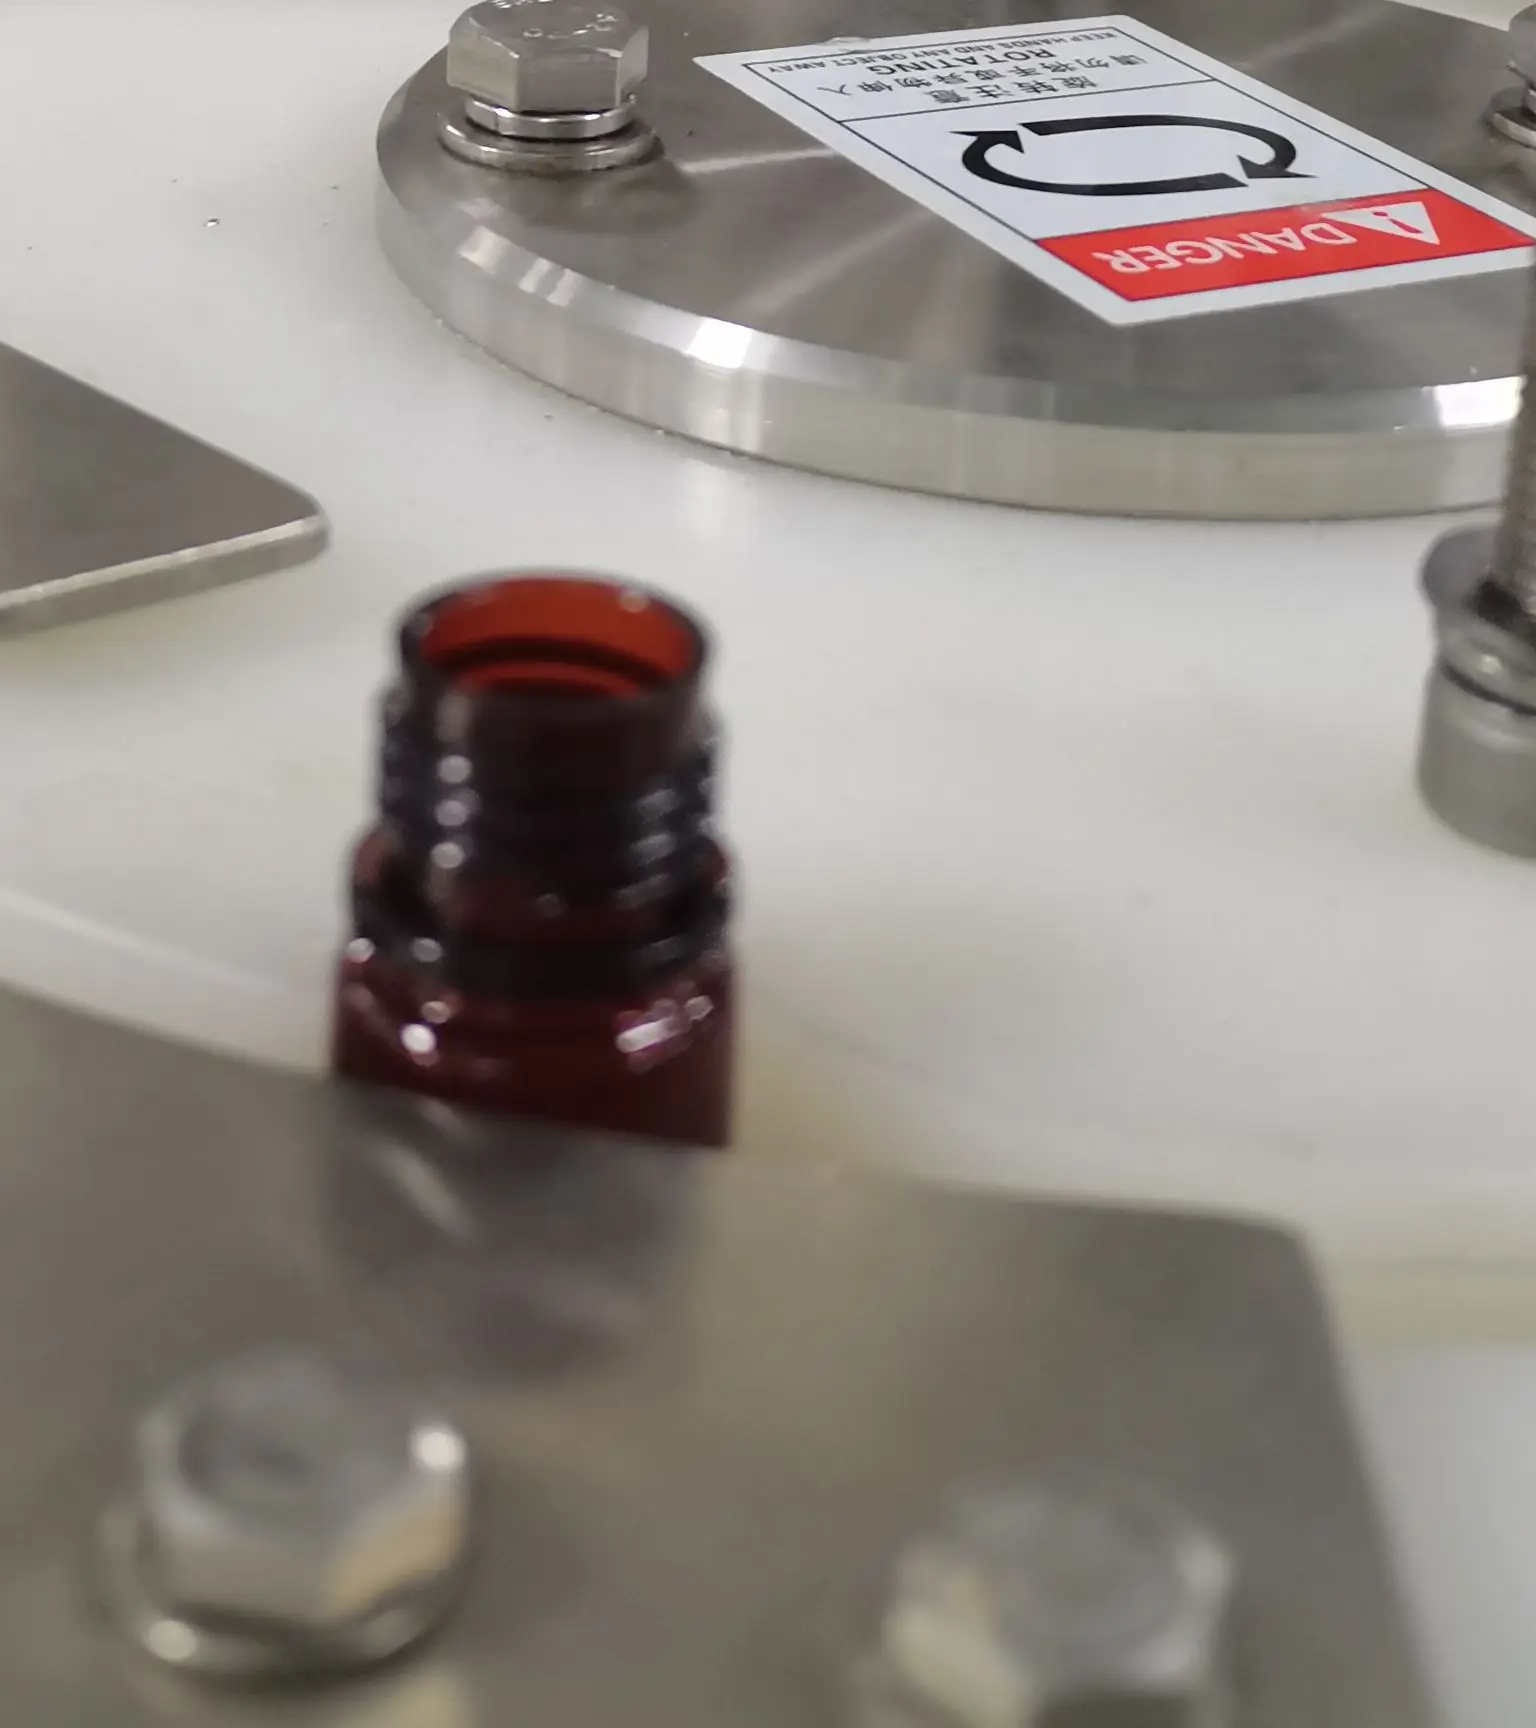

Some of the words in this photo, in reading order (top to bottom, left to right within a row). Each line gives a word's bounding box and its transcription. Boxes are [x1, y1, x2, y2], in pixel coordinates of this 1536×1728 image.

[998, 36, 1068, 49] HANDS
[1071, 31, 1117, 42] KEEP
[911, 48, 951, 58] ANY
[954, 44, 998, 54] AND
[831, 52, 907, 66] OBJECT
[866, 48, 1057, 75] ROTATING
[768, 61, 826, 73] AWAY
[815, 54, 1147, 97] 请勿将手或异物伸入
[923, 75, 1098, 103] 旋转注意
[1092, 222, 1358, 273] DANGER
